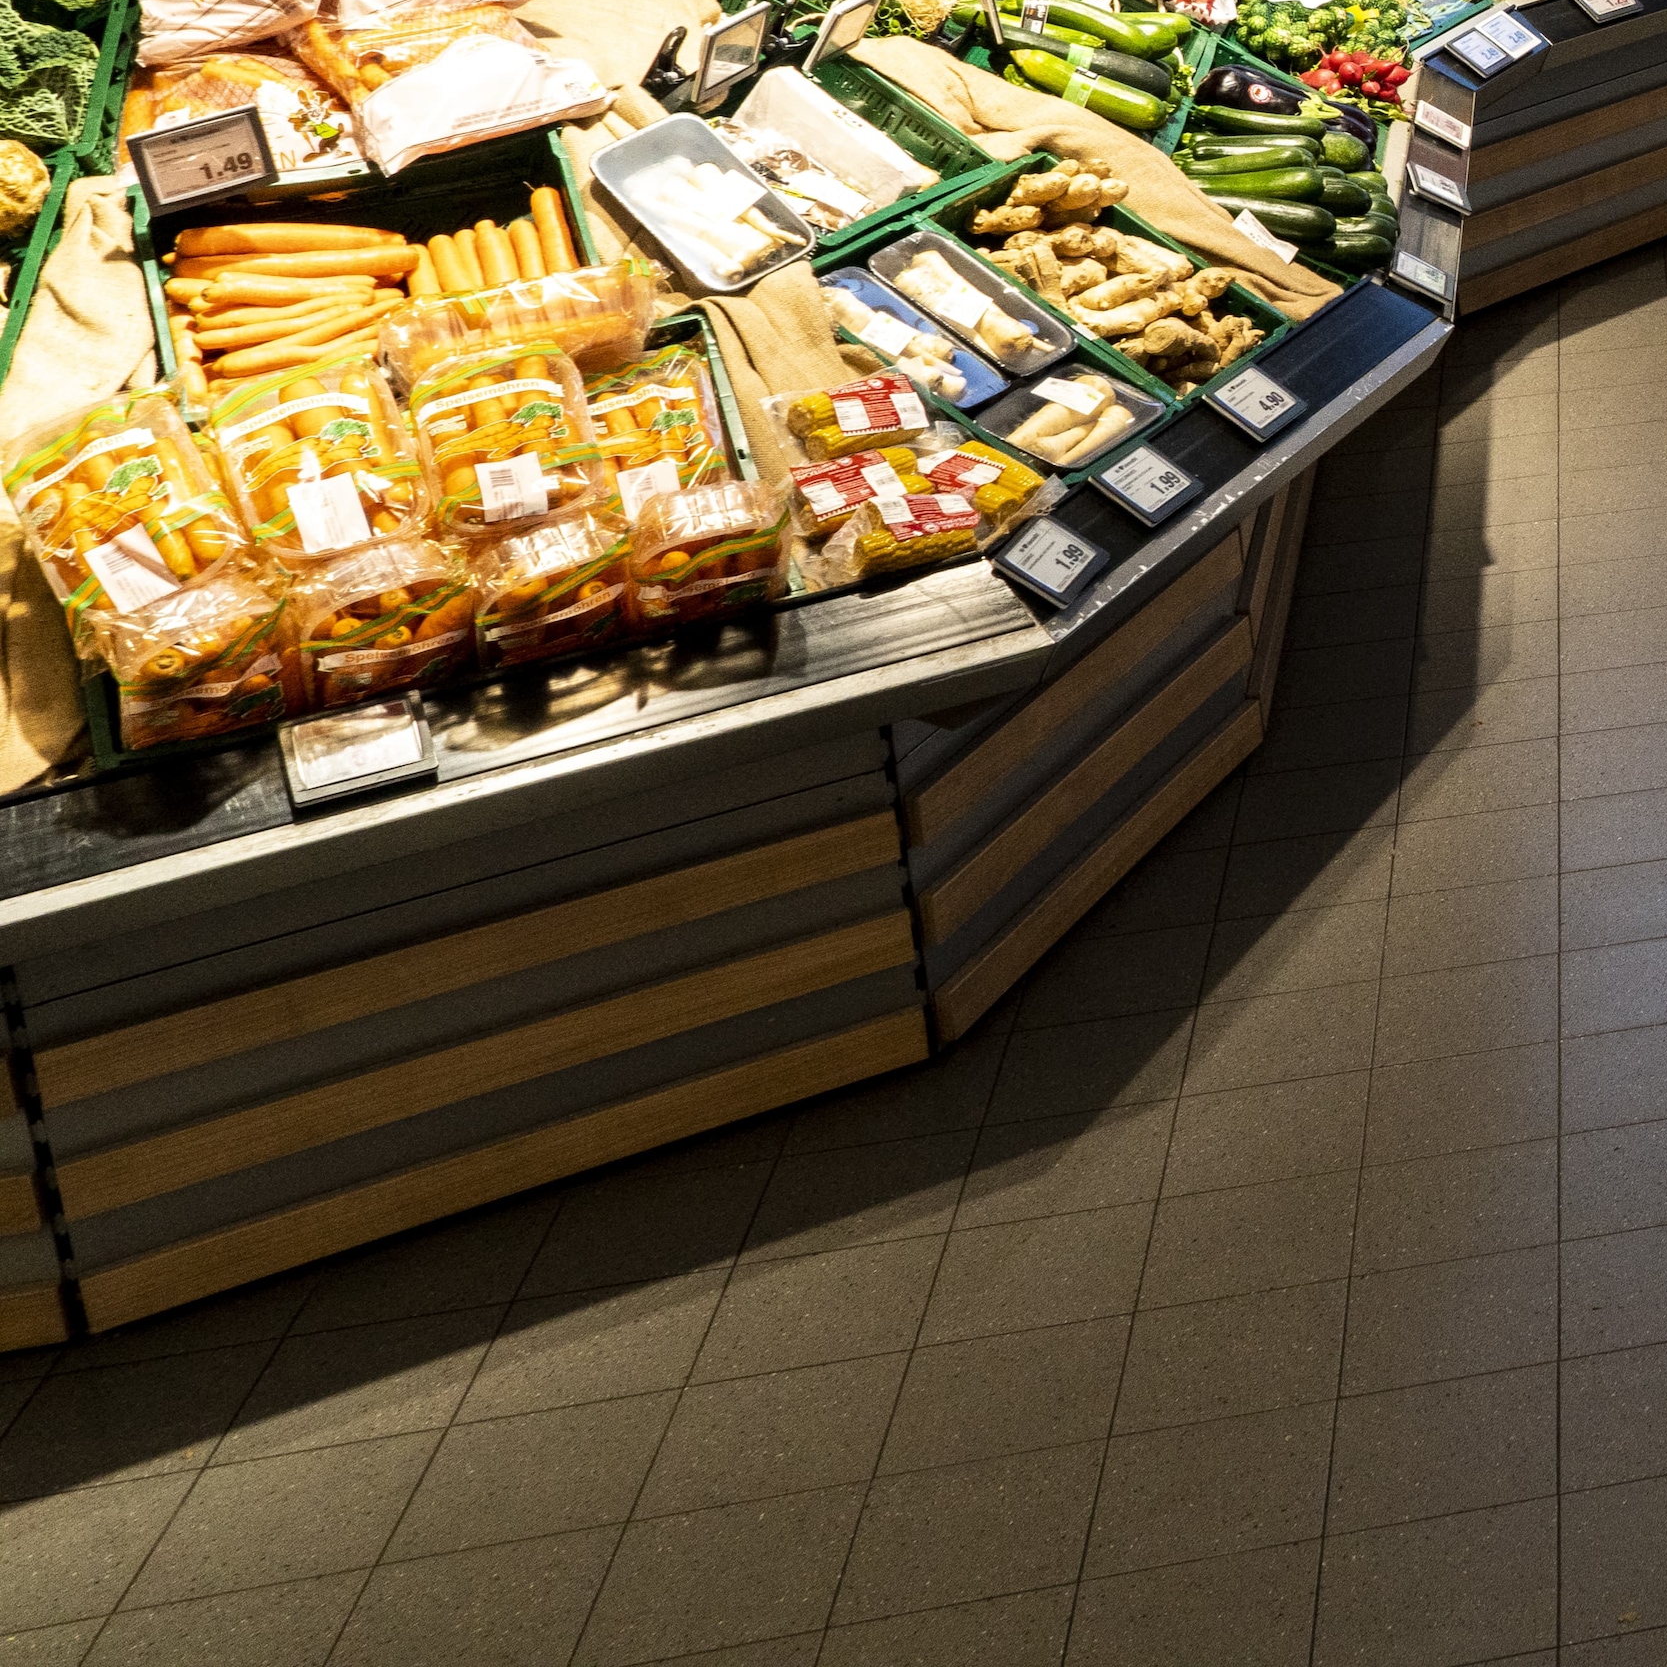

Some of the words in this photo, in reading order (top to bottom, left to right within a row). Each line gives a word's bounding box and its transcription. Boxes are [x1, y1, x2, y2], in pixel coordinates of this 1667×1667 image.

[200, 152, 252, 181] 1.49
[433, 378, 542, 412] Speisemöhren
[1150, 469, 1179, 496] 1.99
[1052, 541, 1087, 574] 1.99
